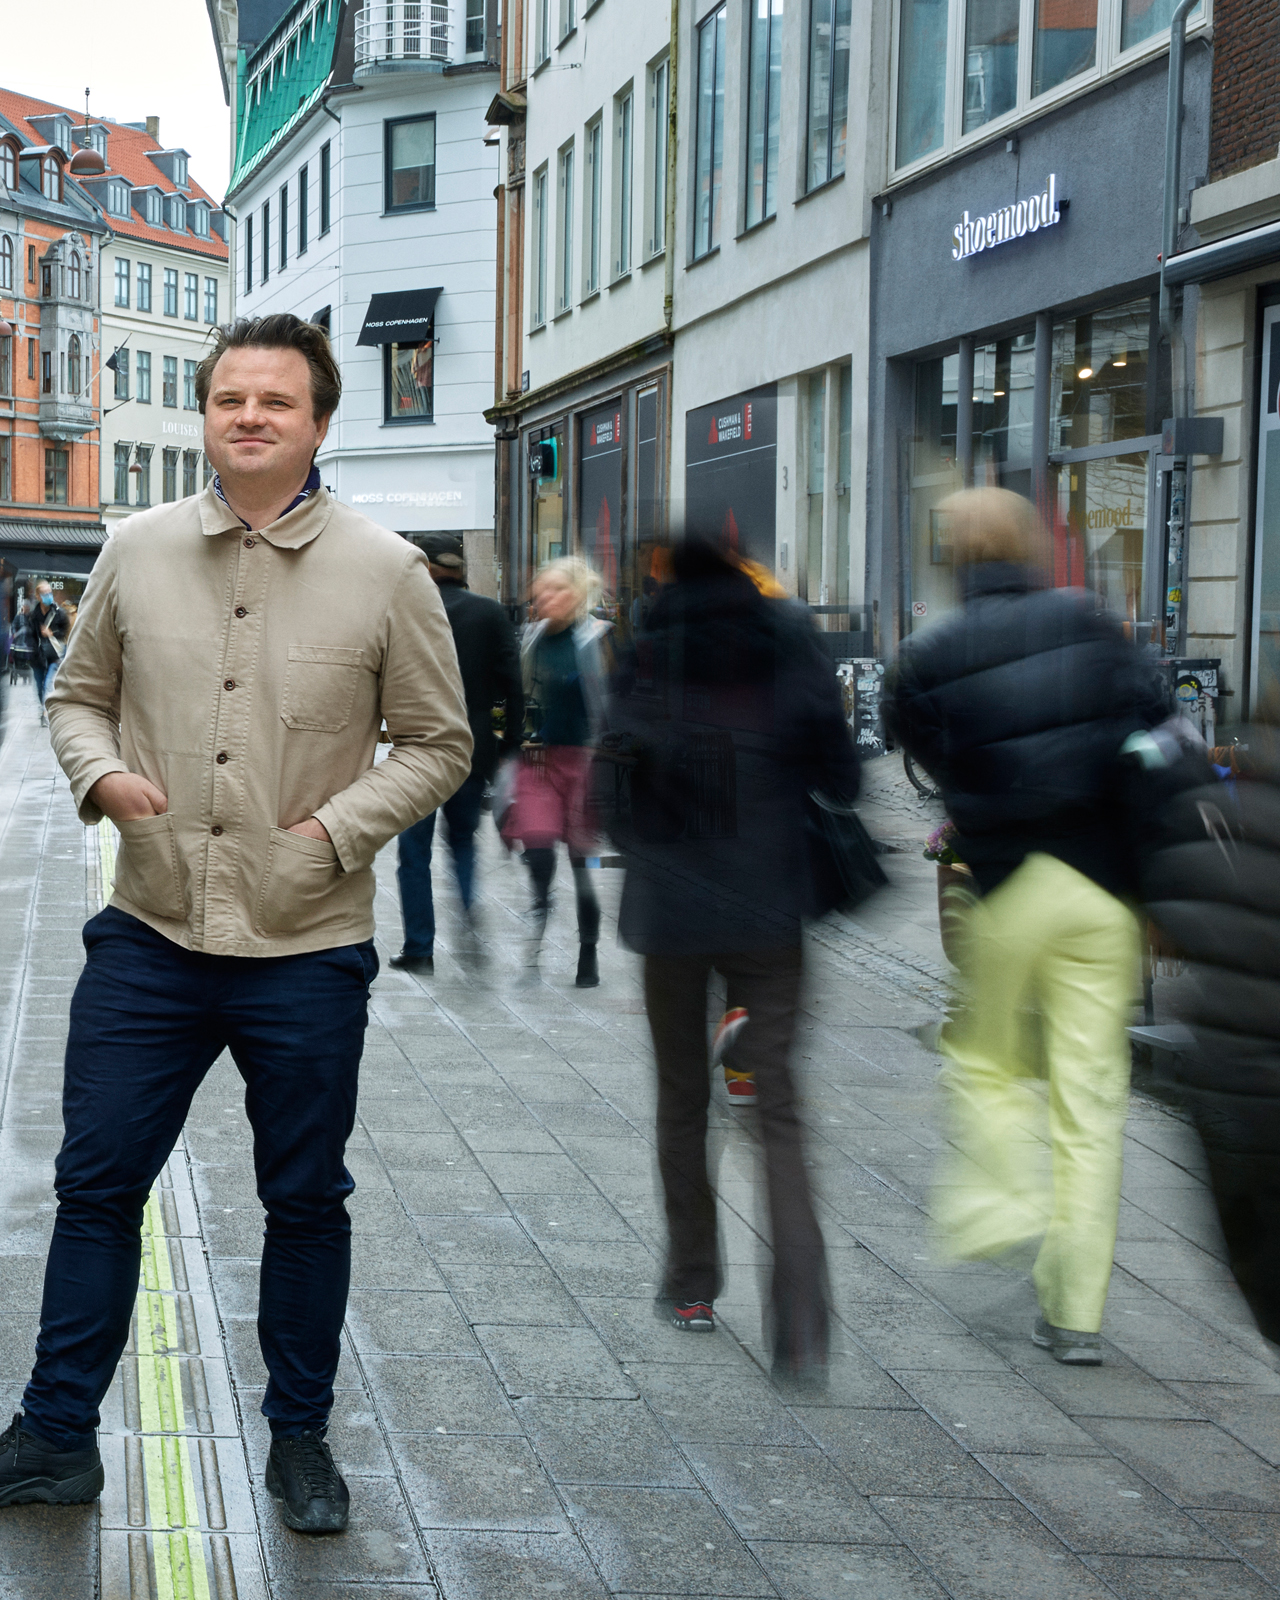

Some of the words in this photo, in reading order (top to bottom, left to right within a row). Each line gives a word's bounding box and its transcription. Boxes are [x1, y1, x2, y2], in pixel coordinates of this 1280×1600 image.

[951, 173, 1060, 261] shoemood.
[385, 317, 429, 327] COPENHAGEN
[162, 421, 199, 437] LOUISES
[718, 413, 738, 430] CUSHMAN
[718, 425, 742, 442] WAKEFIELD
[782, 465, 789, 491] 3
[1155, 469, 1162, 488] 5
[351, 493, 384, 504] MOSS
[386, 491, 462, 503] COPENHAGEN
[1067, 499, 1134, 530] soemood.
